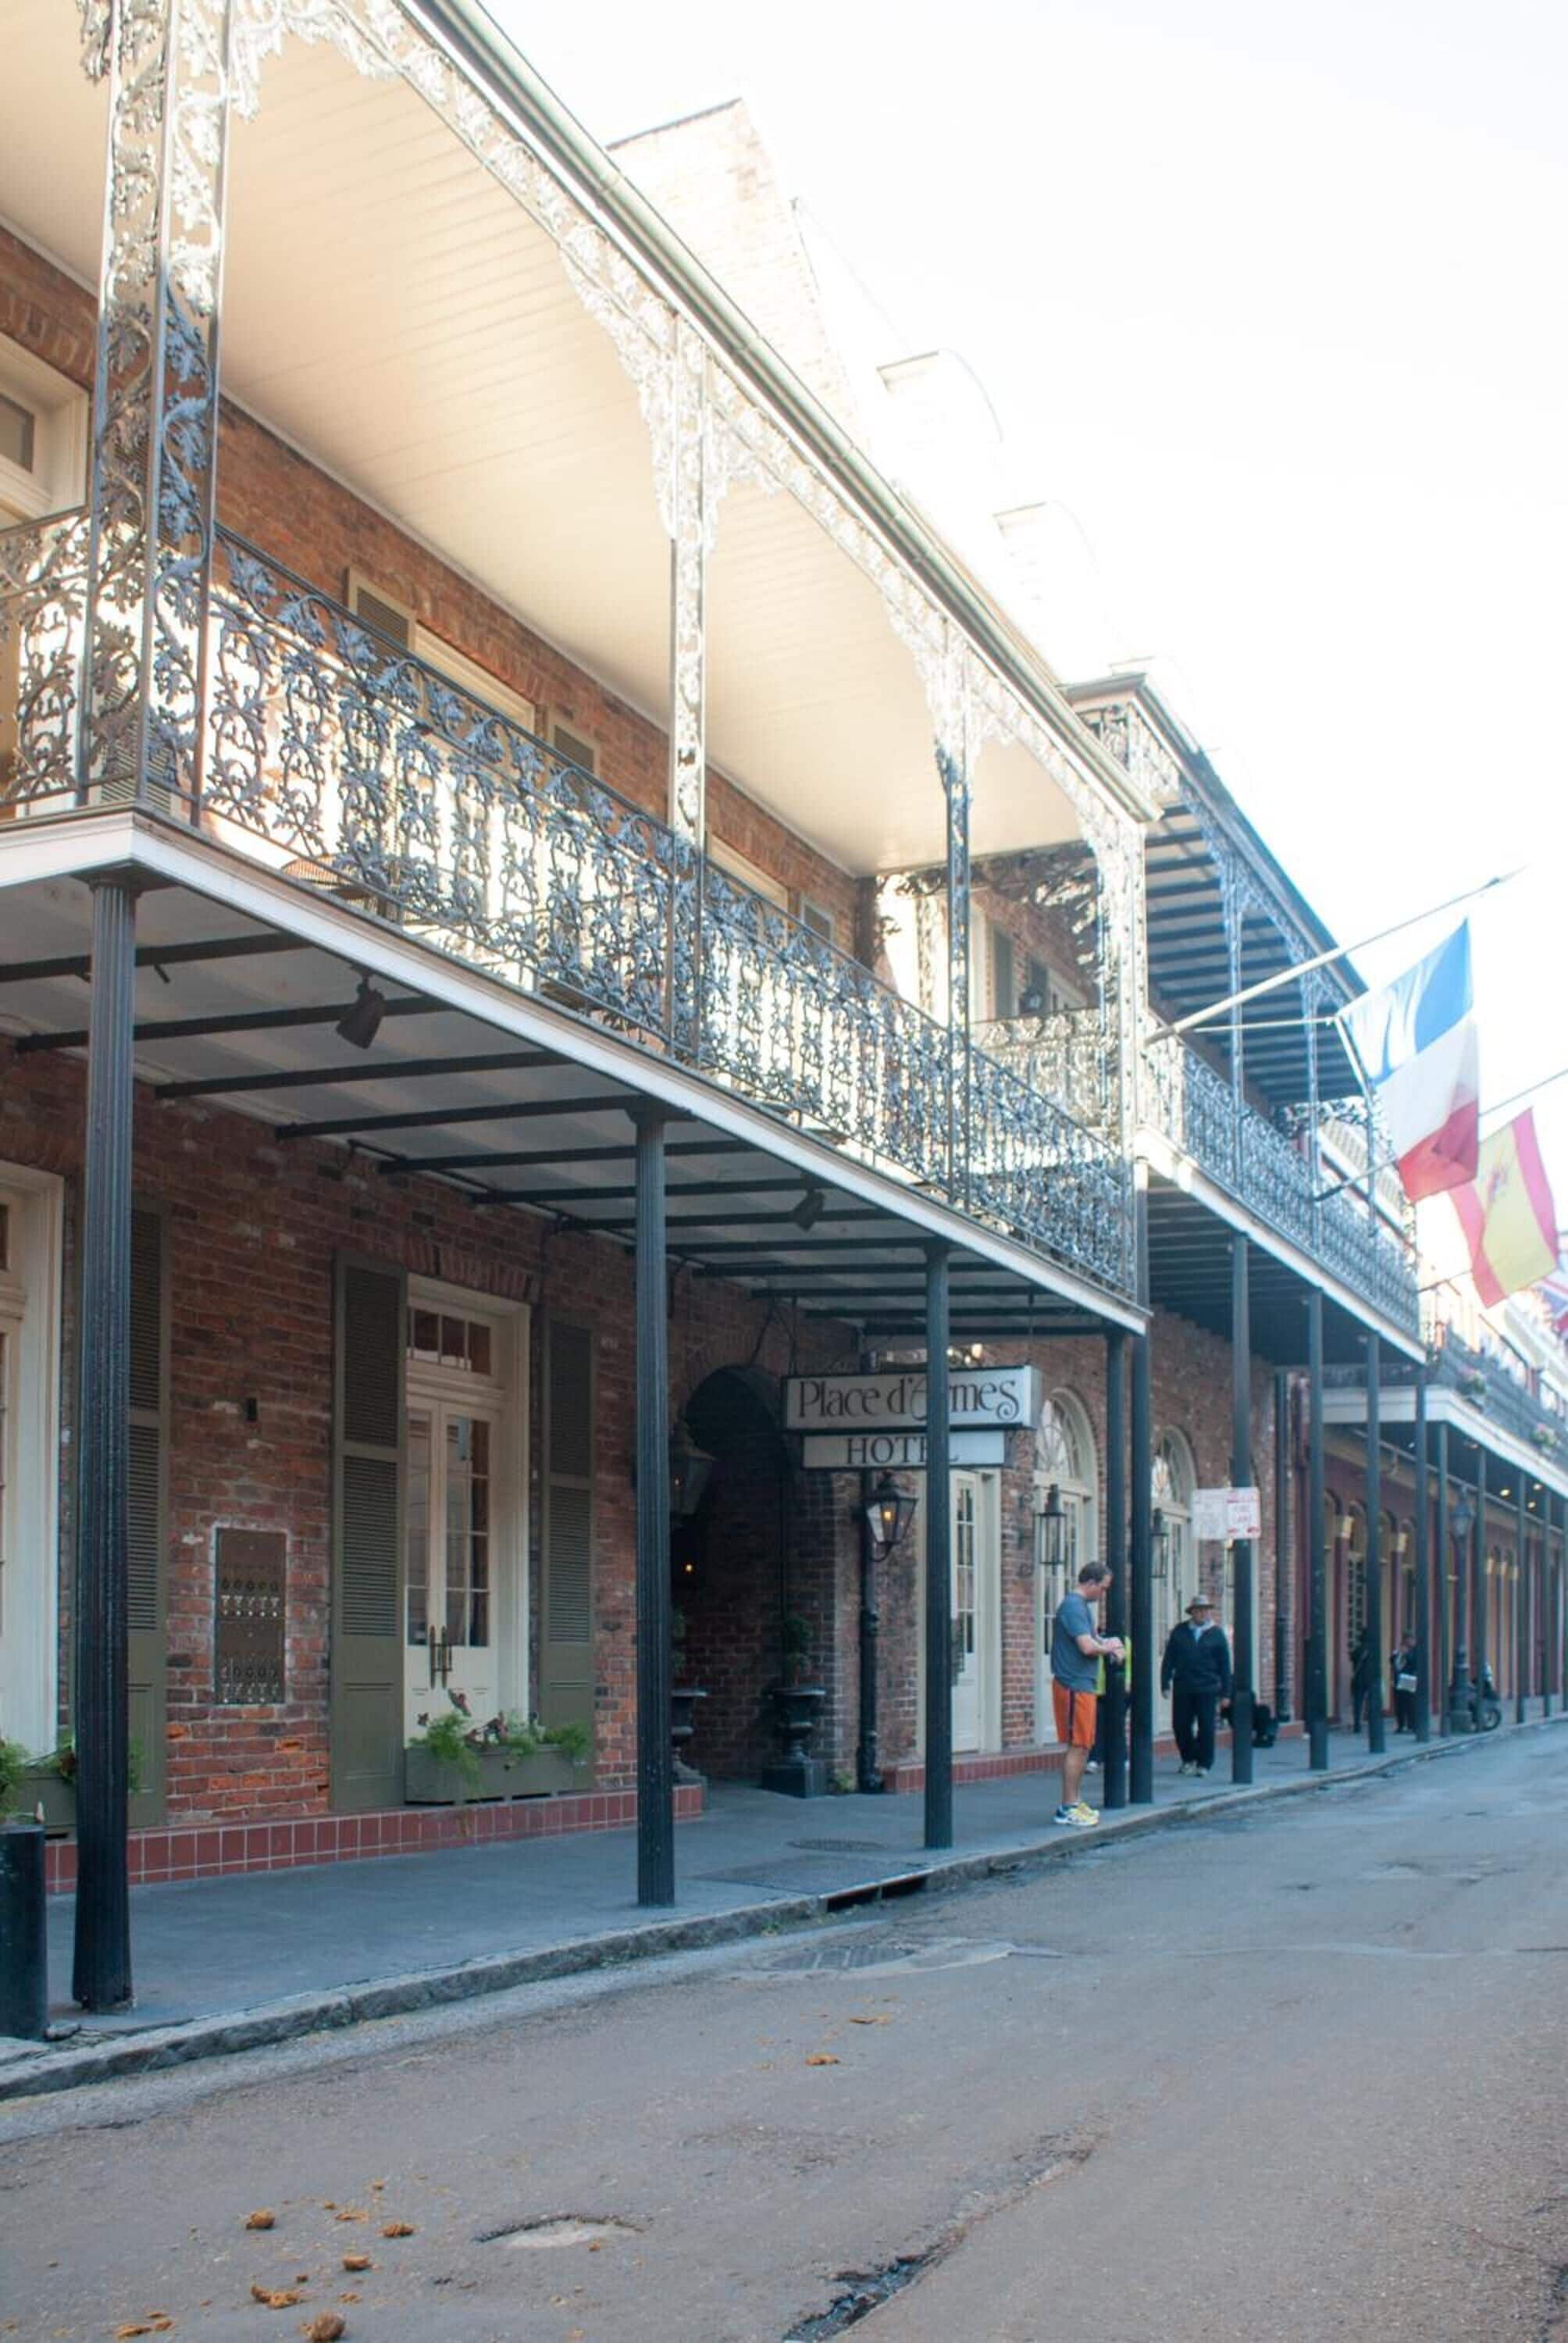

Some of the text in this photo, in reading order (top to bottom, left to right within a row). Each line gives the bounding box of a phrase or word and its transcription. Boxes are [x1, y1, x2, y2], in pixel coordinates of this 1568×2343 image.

[798, 1376, 1019, 1421] Place d'mes
[846, 1435, 959, 1464] HOT
